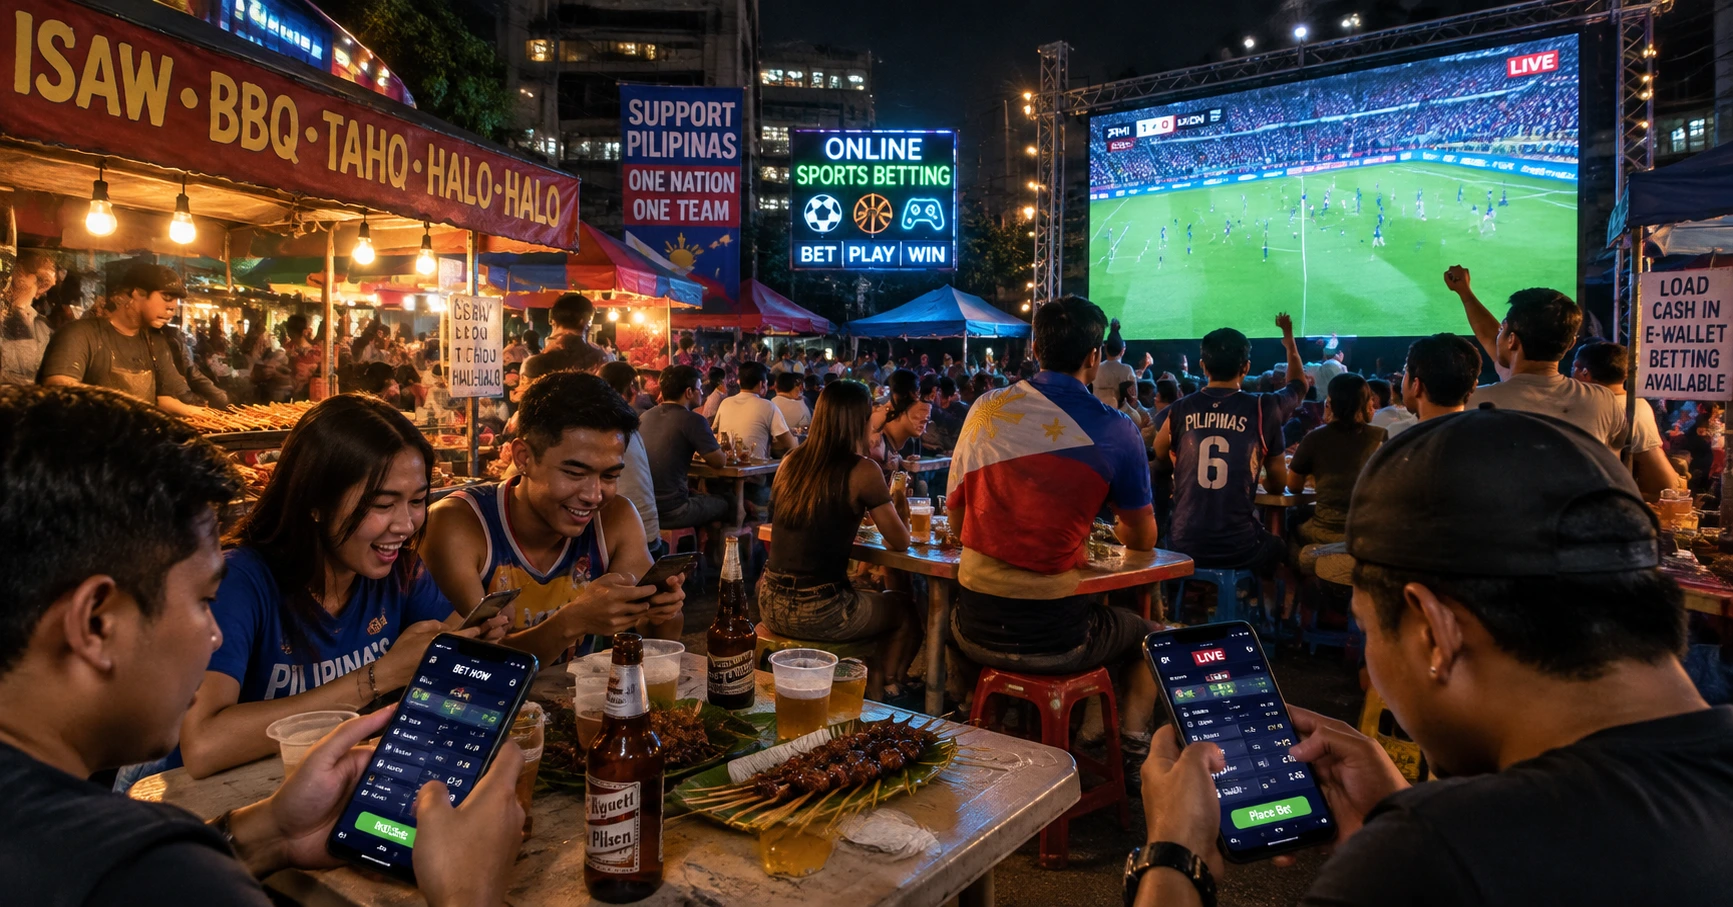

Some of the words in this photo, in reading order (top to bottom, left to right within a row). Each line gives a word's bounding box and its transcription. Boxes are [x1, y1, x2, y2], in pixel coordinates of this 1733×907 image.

[1510, 53, 1555, 75] LIVE
[14, 10, 174, 127] ISAW
[209, 70, 299, 164] BBQ
[628, 98, 735, 127] SUPPORT
[627, 130, 737, 160] PILIPINAS
[825, 137, 923, 161] ONLINE
[628, 169, 665, 192] ONE
[670, 171, 735, 194] NATION
[796, 165, 868, 186] SPORTS
[873, 165, 951, 186] BETTING
[633, 198, 670, 221] ONE
[677, 199, 730, 221] TEAM
[801, 245, 837, 263] BET
[849, 245, 896, 263] PLAY
[907, 246, 946, 263] WIN
[1660, 276, 1709, 297] LOAD
[1652, 301, 1696, 320] CASH
[1702, 300, 1721, 319] IN
[1645, 324, 1728, 344] E-WALLET
[1649, 349, 1720, 368] BETTING
[1644, 373, 1726, 393] AVAILABLE
[1185, 412, 1248, 433] PILIPINAS
[1197, 435, 1230, 490] 6
[1196, 650, 1225, 663] LIVE
[452, 663, 470, 676] BET
[1248, 809, 1275, 821] Place
